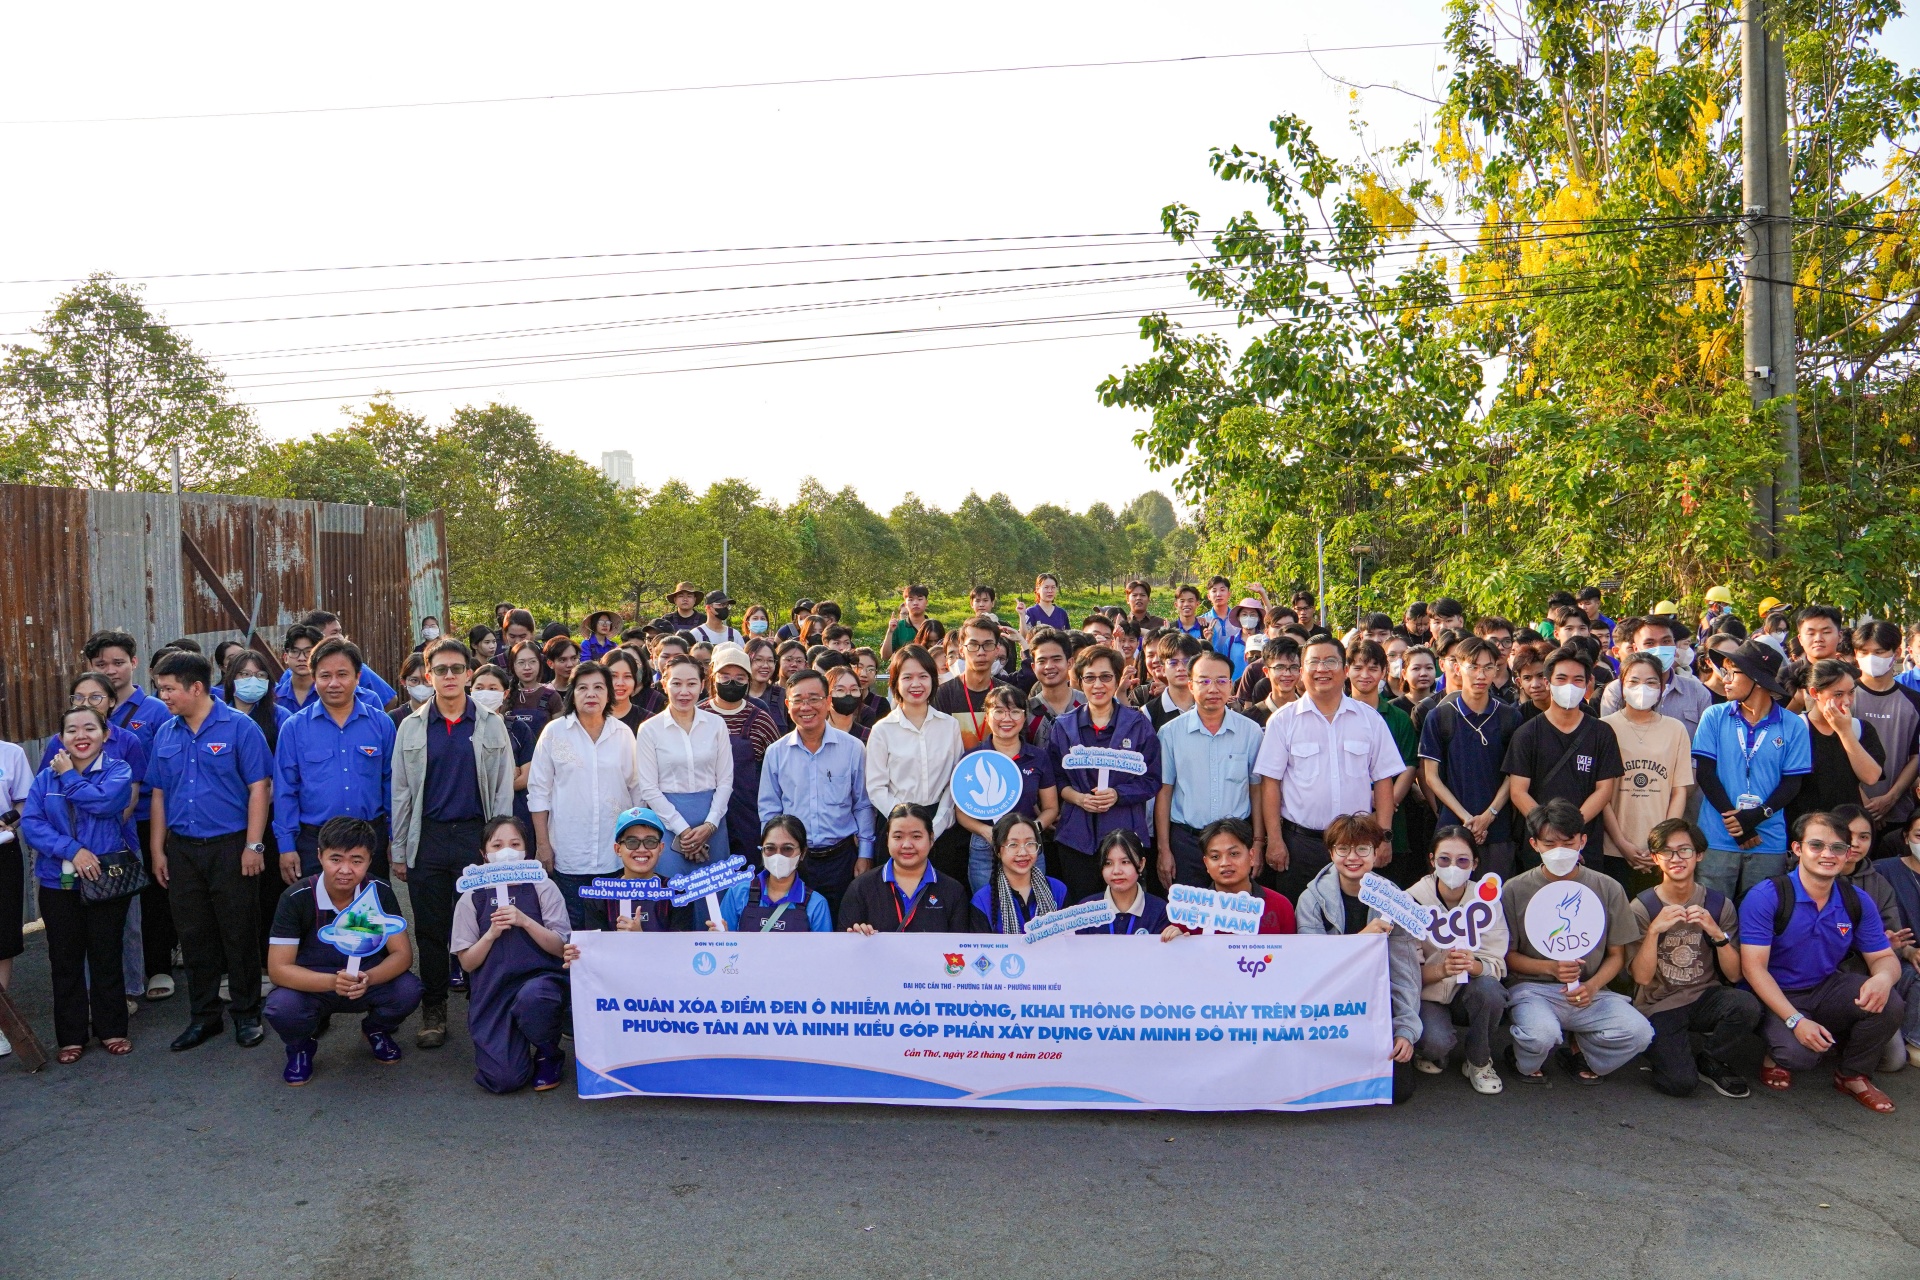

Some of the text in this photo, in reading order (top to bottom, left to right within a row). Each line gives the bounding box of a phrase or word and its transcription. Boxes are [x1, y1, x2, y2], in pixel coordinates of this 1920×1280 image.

[1577, 754, 1592, 764] ME
[1577, 764, 1591, 773] WE
[973, 807, 986, 815] SINH
[1008, 789, 1017, 802] NAM
[490, 872, 515, 883] BINH
[514, 870, 545, 881] XANH
[709, 862, 727, 874] sinh
[594, 879, 627, 888] CHUNG
[629, 880, 646, 888] TAY
[687, 877, 711, 891] chung
[711, 872, 724, 882] tay
[581, 887, 673, 899] NGUỒN NƯỚC SẠCH
[1172, 887, 1261, 914] SINH VIÊN
[1089, 912, 1113, 925] SẠCH
[1170, 906, 1256, 933] VIỆT NAM
[1426, 901, 1493, 947] tcp
[1542, 931, 1591, 954] VSDS
[1236, 956, 1267, 978] tcp
[596, 995, 1367, 1021] RA QUÂN XÓA ĐIỂM ĐEN Ô NHIỄM MÔI TRƯỜNG, KHAI THÔNG DÒNG CHẢY TRÊN ĐỊA BÀN
[622, 1017, 1349, 1045] PHƯỜNG TÂN AN VÀ NINH KIỀU GÓP PHẦN XÂY DỰNG VĂN MINH ĐÔ THỊ NĂM 2026
[904, 1047, 921, 1058] Cần
[943, 1050, 965, 1060] ngày
[966, 1051, 979, 1059] 22
[980, 1050, 1006, 1061] tháng
[1008, 1051, 1014, 1059] 4
[1015, 1051, 1036, 1060] năm
[1037, 1051, 1063, 1060] 2026
